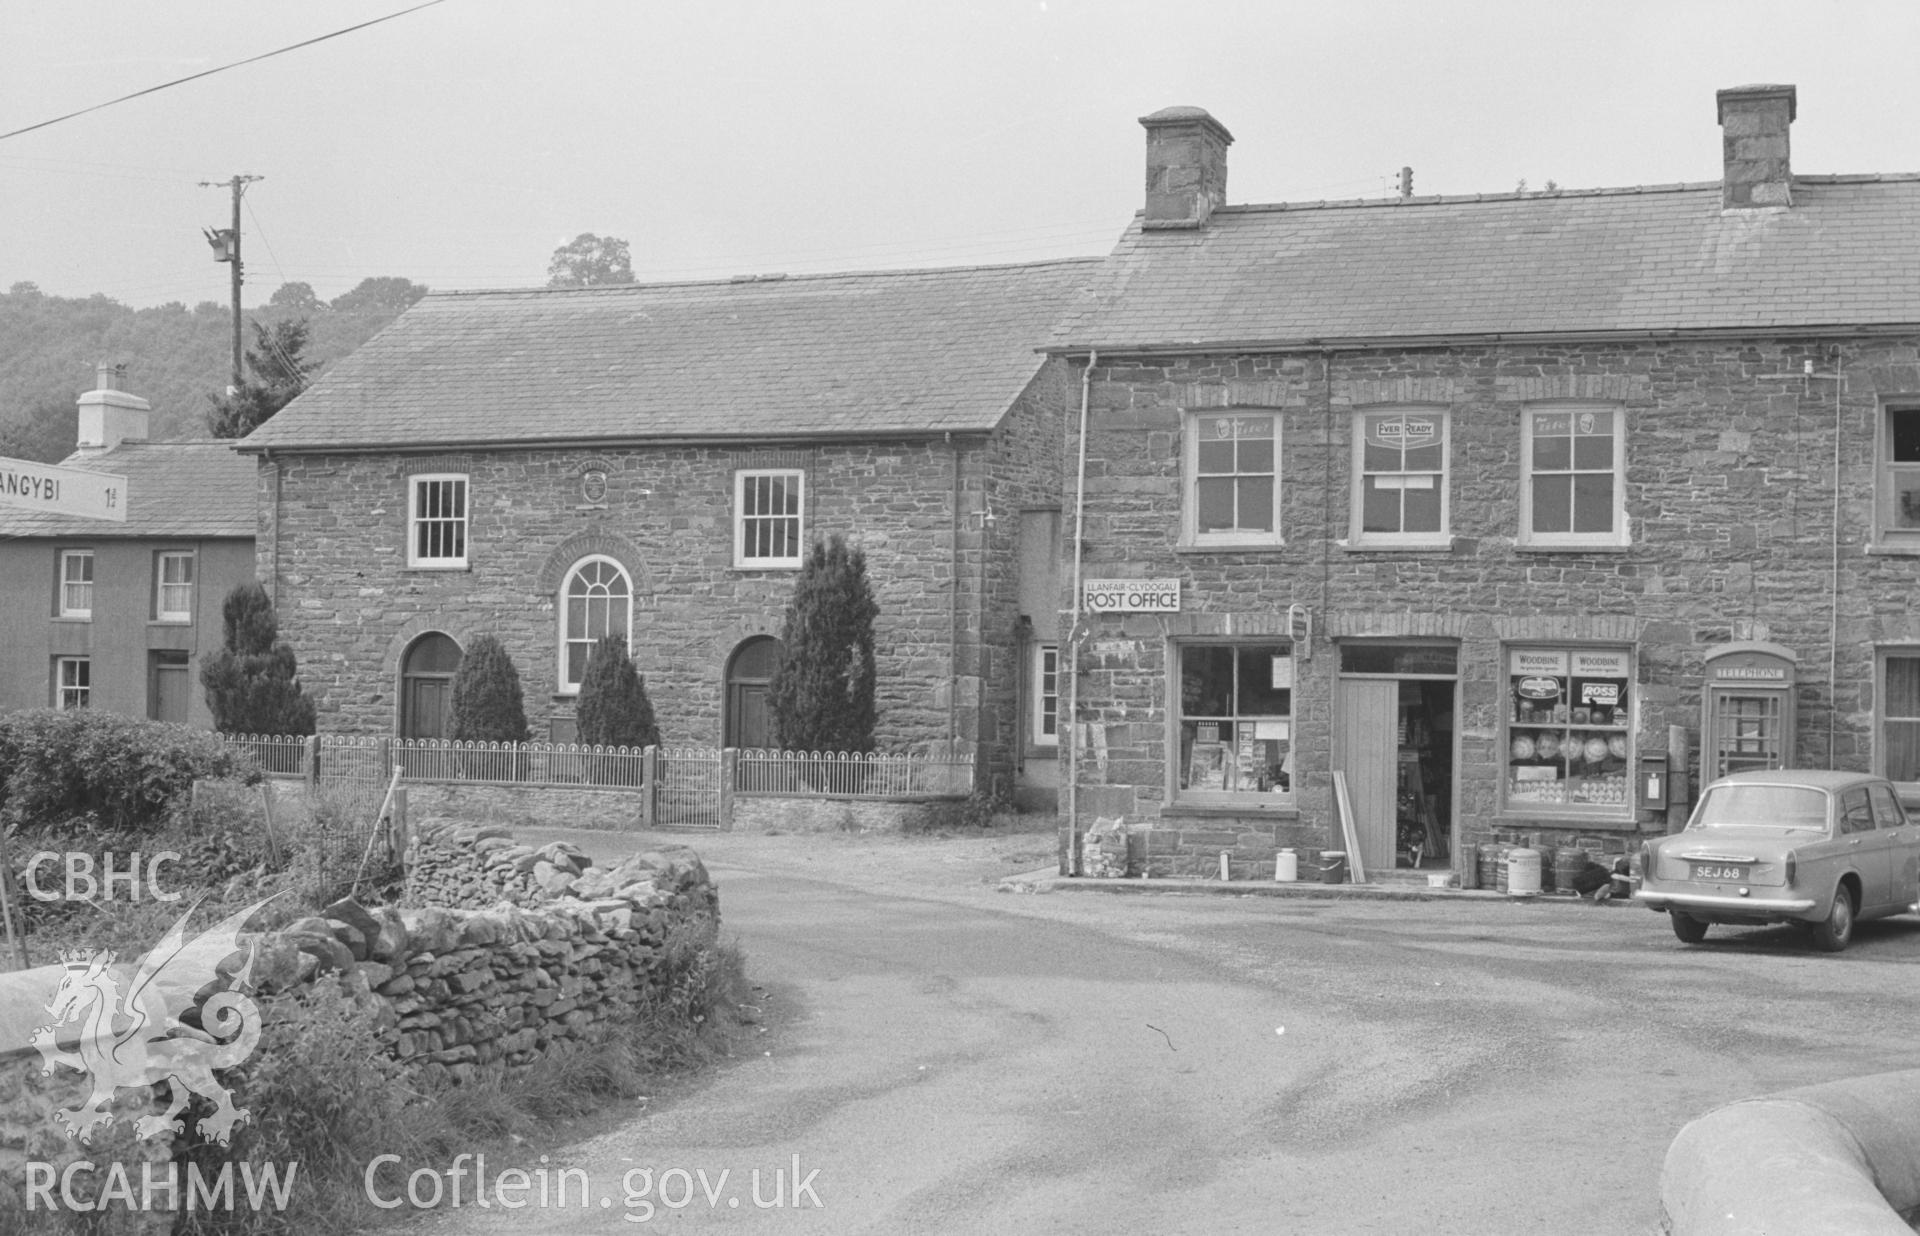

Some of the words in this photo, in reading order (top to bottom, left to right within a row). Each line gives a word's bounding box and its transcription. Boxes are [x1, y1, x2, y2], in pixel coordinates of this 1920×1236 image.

[1378, 423, 1400, 436] EVER
[1404, 423, 1432, 436] READY
[1086, 592, 1125, 608] POST
[1128, 592, 1177, 608] OFFICE
[1519, 655, 1560, 665] WOODBINE
[1579, 655, 1620, 666] WOODBINE
[1717, 668, 1781, 679] TELEPHONE
[1584, 686, 1617, 697] ROSS
[1696, 866, 1721, 878] SEJ
[1723, 867, 1740, 879] 68
